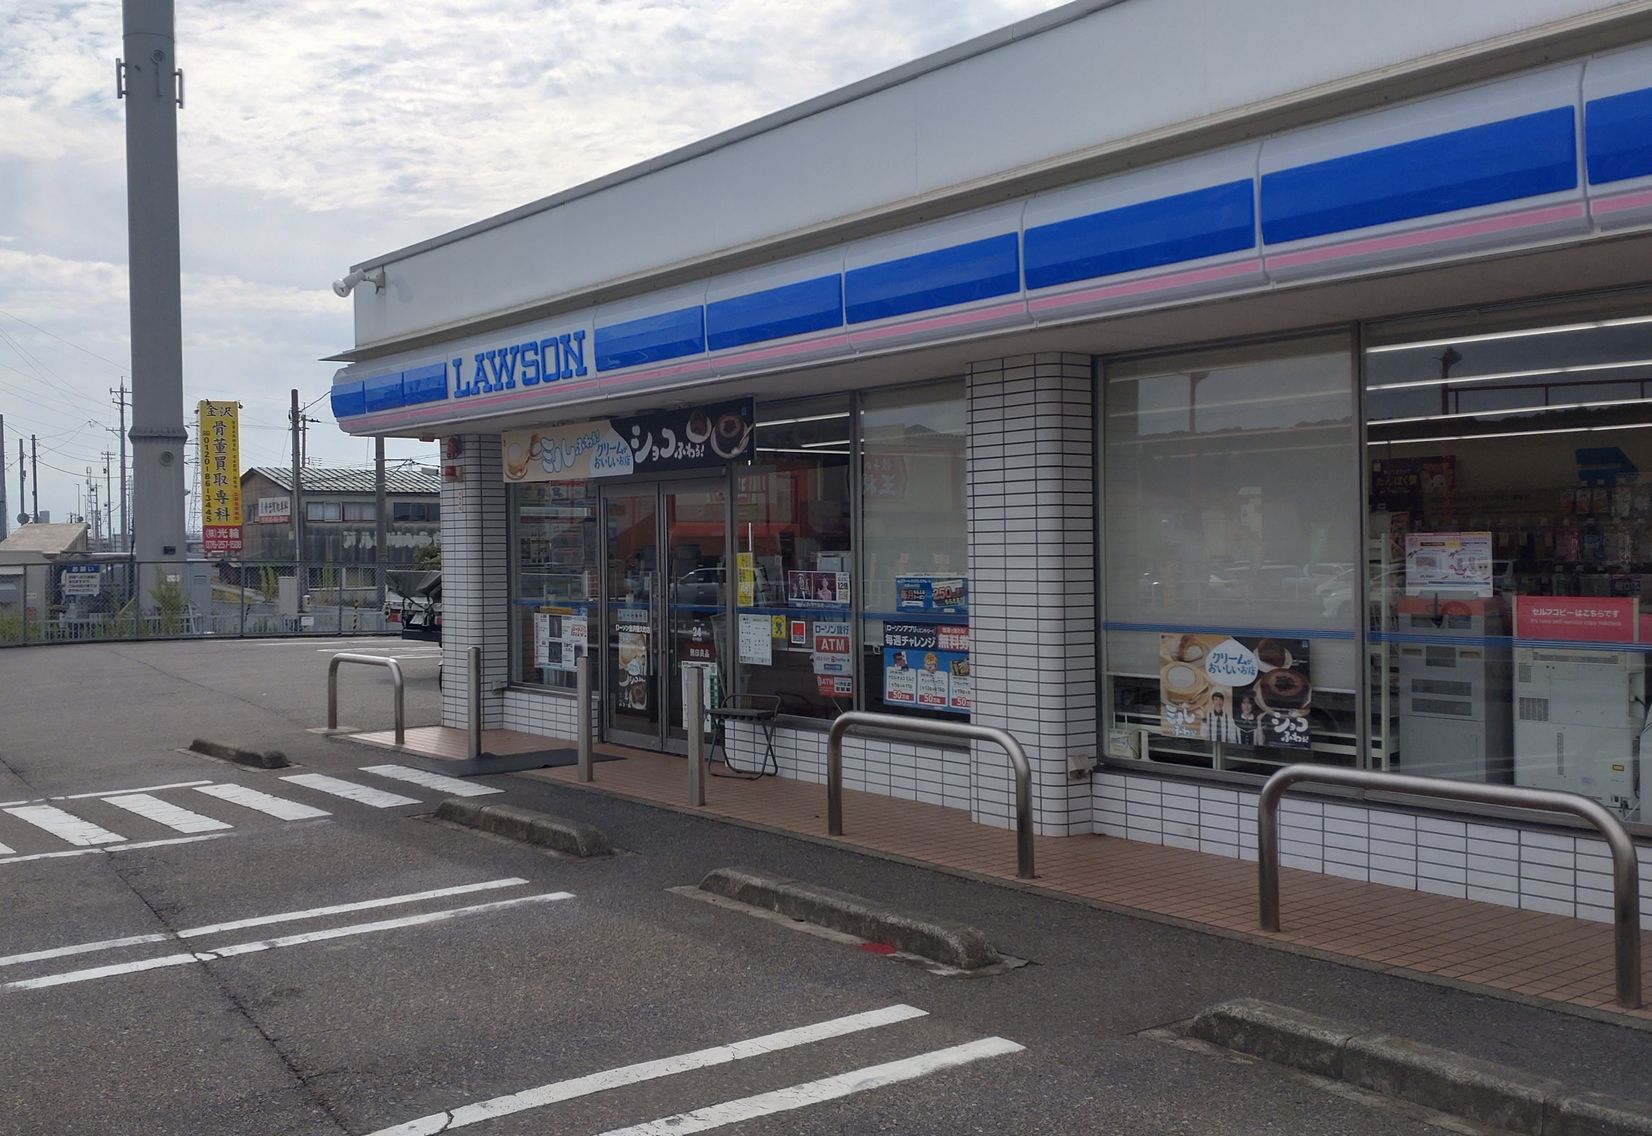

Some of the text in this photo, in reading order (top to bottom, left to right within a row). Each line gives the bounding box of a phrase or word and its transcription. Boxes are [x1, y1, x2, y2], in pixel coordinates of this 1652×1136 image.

[452, 329, 589, 399] LAWSON
[206, 405, 234, 418] 金沢
[593, 453, 631, 469] おいしいお店
[212, 420, 230, 522] 骨董買取専科
[1532, 607, 1620, 618] セルフコピーはこちらです
[692, 626, 702, 638] 24
[815, 625, 849, 636] ローソン銀行
[821, 638, 846, 652] ATM
[885, 634, 937, 648] 毎週チャレンジ
[1207, 663, 1257, 676] おいしいお店
[822, 678, 834, 686] ATM
[1271, 711, 1309, 732] ショコ
